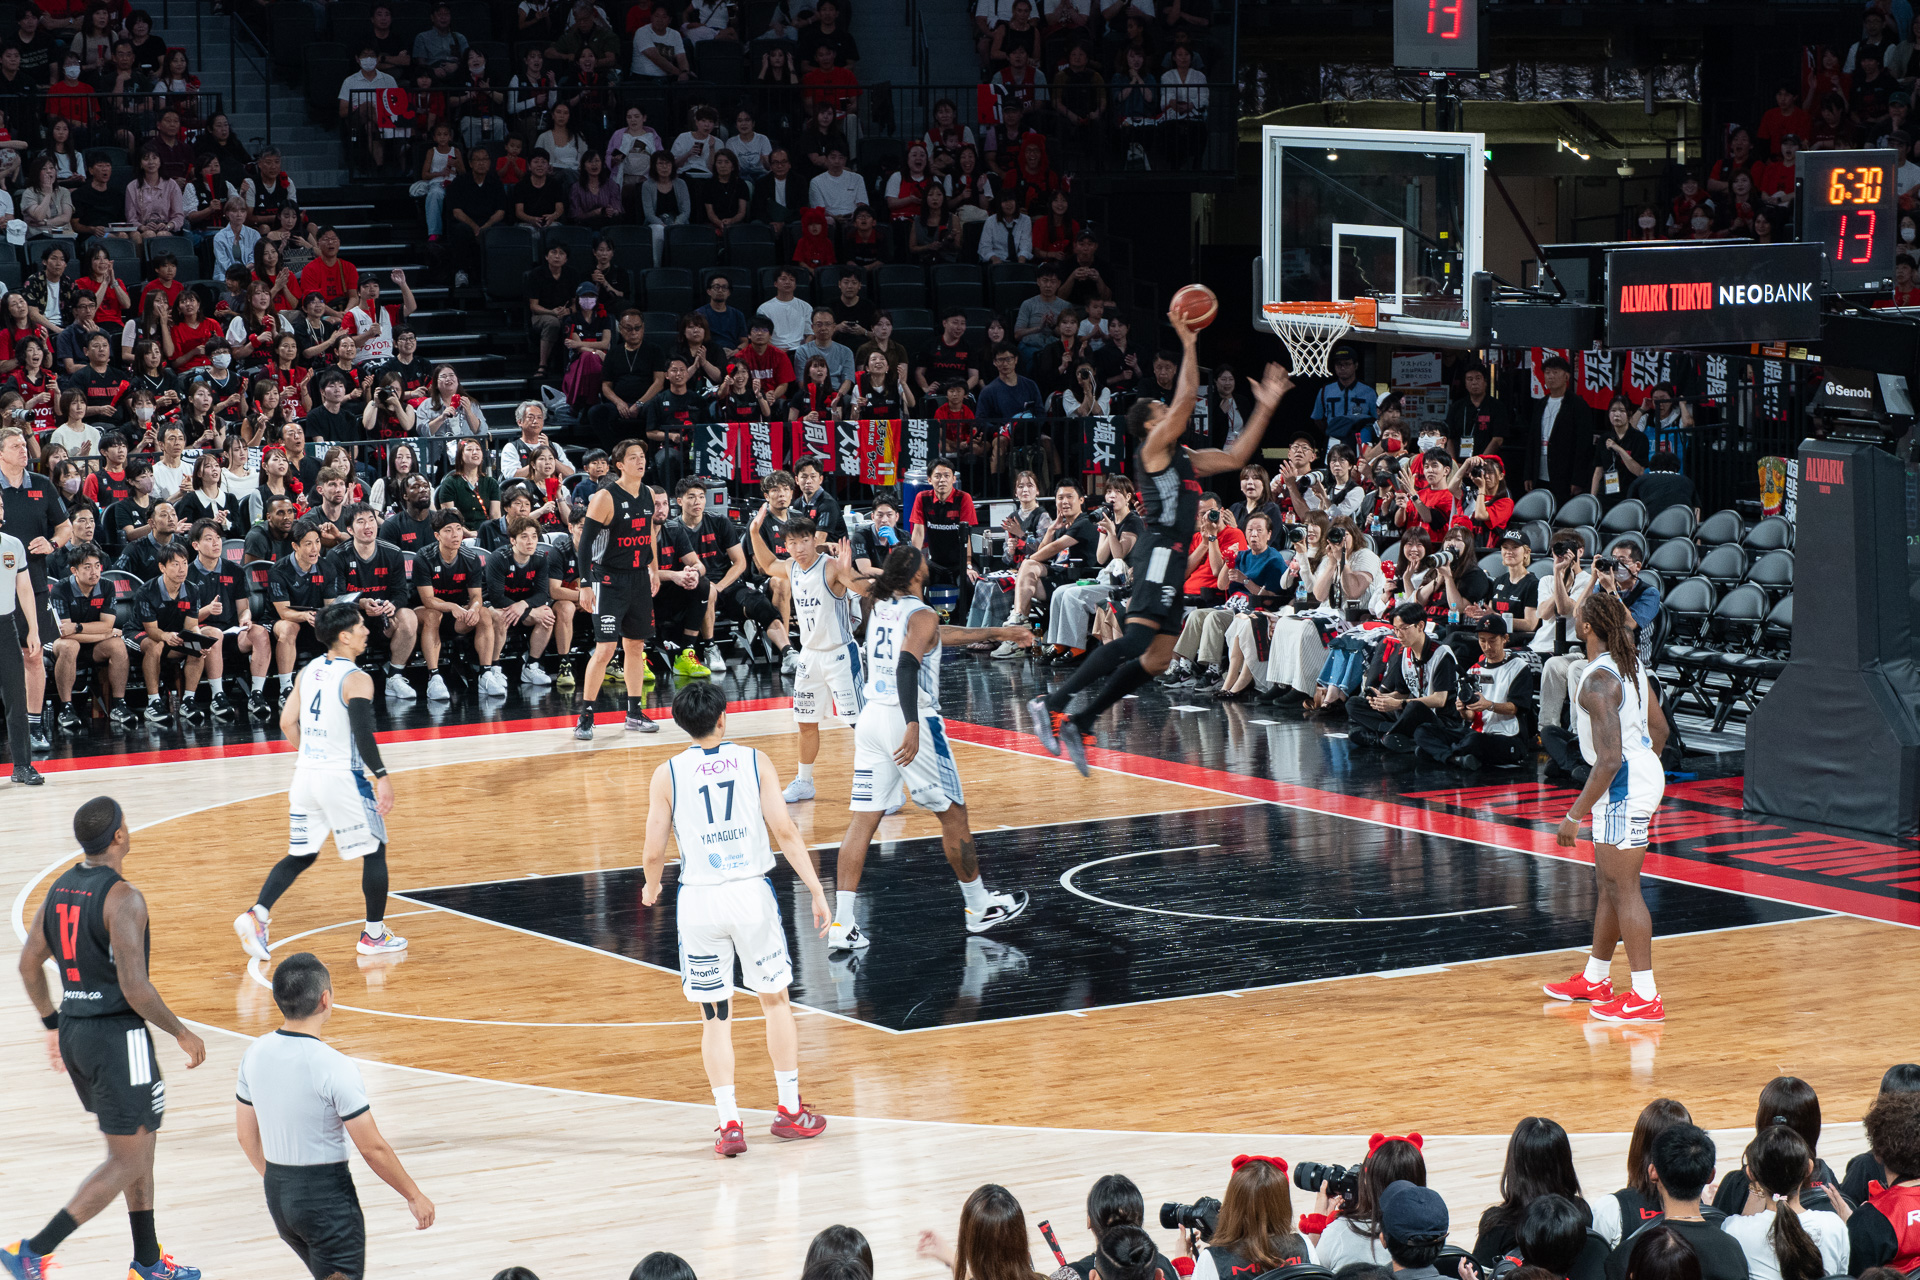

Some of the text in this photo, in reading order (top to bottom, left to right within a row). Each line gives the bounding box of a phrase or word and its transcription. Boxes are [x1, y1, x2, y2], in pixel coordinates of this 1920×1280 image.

[1427, 0, 1462, 38] 13
[1829, 167, 1883, 204] 6:30
[1837, 210, 1876, 263] 13
[1620, 282, 1813, 313] ALVARK TOKYO NEOBANK
[1599, 350, 1614, 391] ZAC
[1631, 351, 1645, 391] STE
[1645, 351, 1659, 387] ZAC
[1836, 385, 1872, 398] Senoh
[706, 423, 734, 480] ス海
[837, 420, 861, 476] ス海
[878, 461, 895, 476] 11
[1805, 457, 1844, 485] ALVARK
[617, 535, 651, 547] TOYOTA
[633, 550, 640, 568] 3
[874, 627, 894, 660] 25
[310, 689, 322, 721] 4
[698, 780, 735, 824] 17
[700, 827, 748, 845] YAMAGUCHI
[690, 966, 720, 978] Arromic
